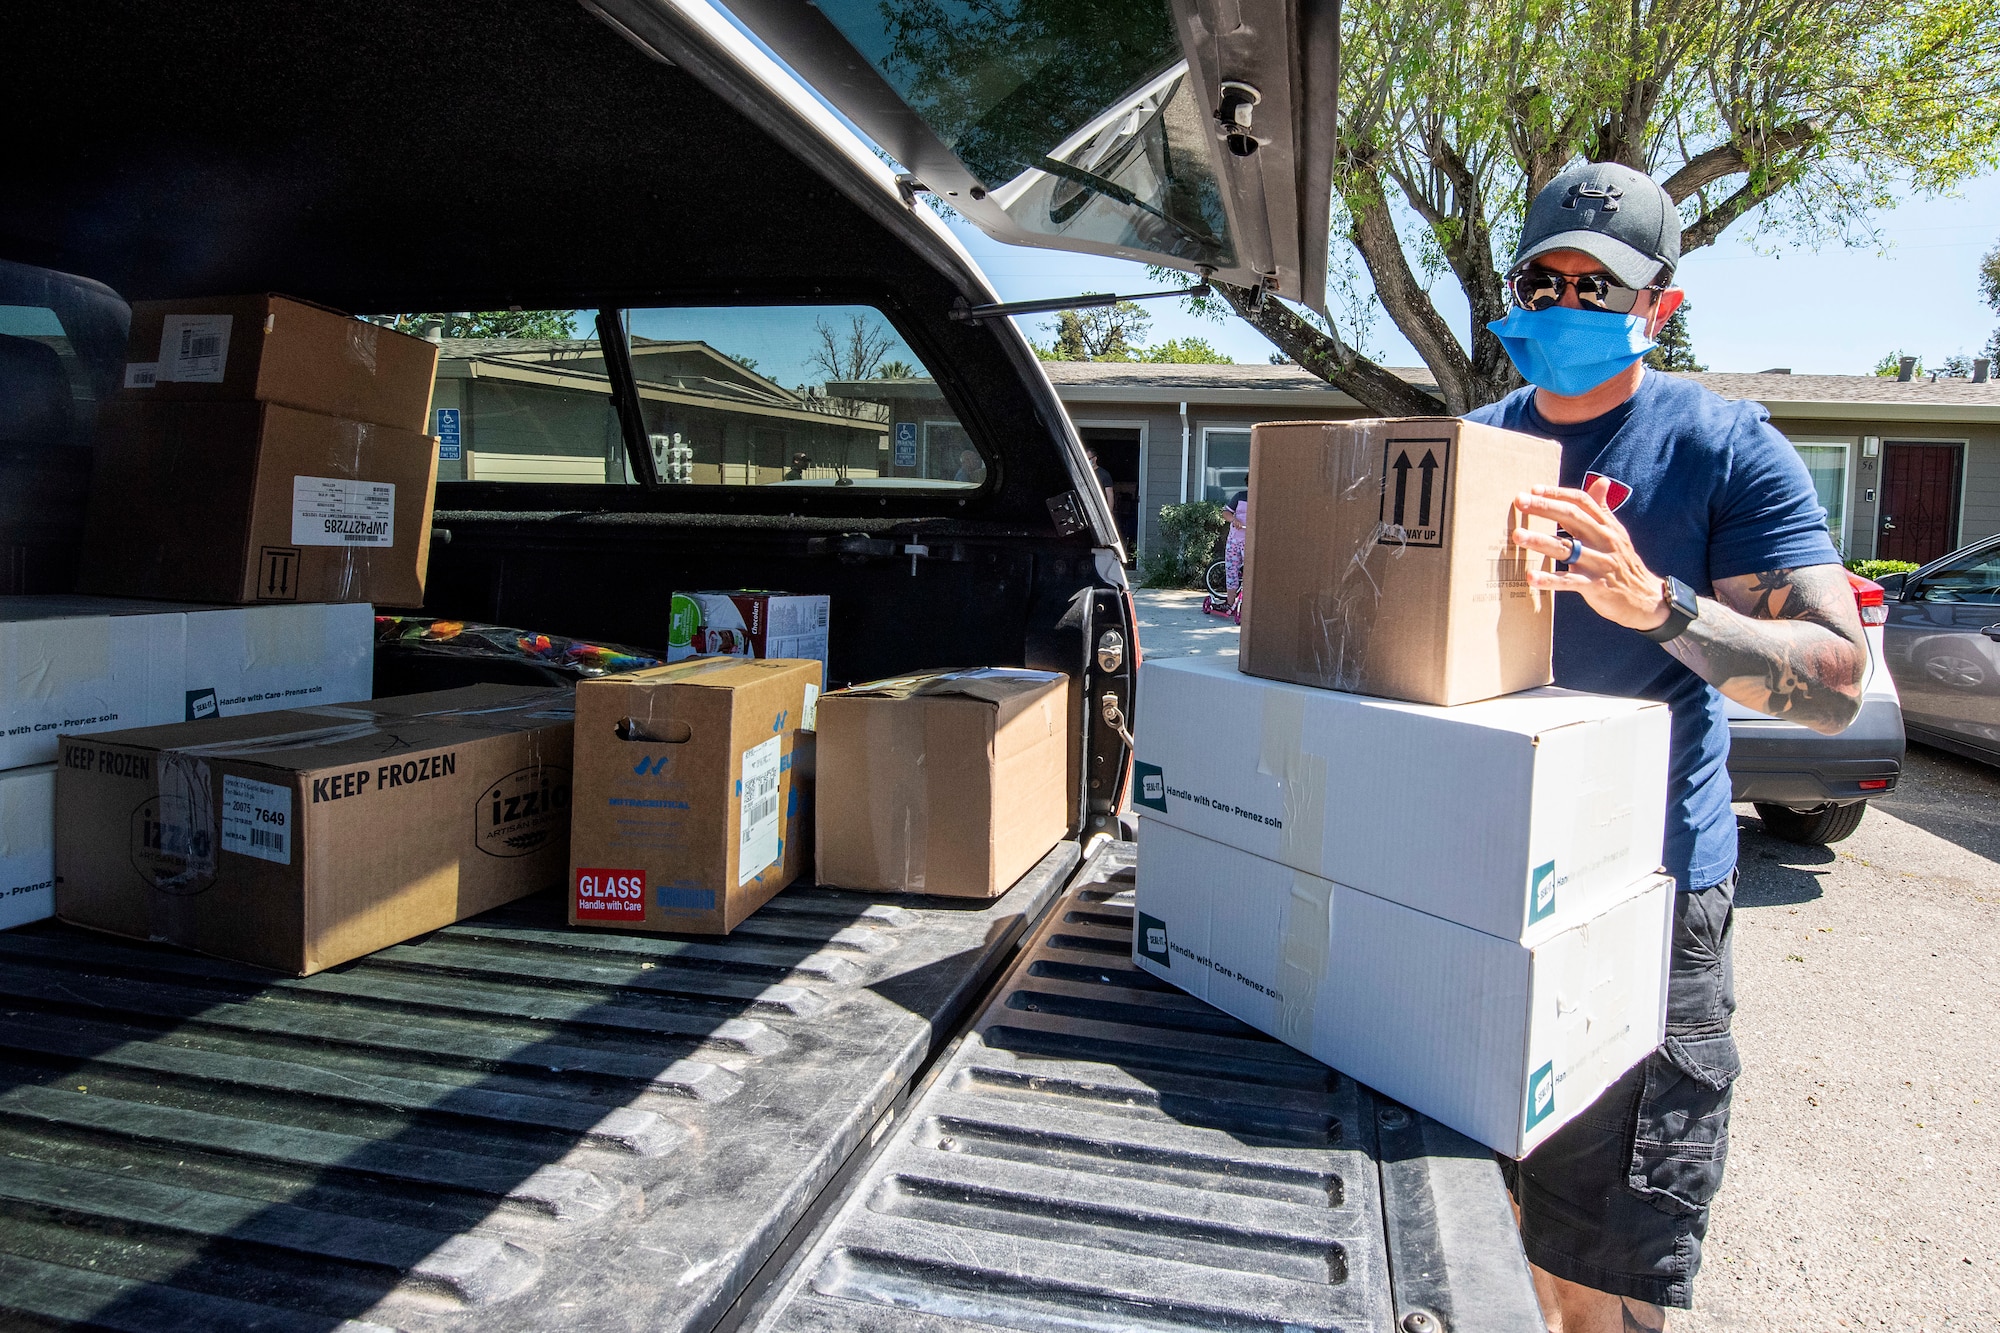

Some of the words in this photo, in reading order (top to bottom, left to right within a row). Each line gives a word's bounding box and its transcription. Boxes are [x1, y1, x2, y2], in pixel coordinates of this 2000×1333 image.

[1862, 460, 1873, 471] 56
[324, 519, 388, 535] JWP4277285
[1424, 530, 1436, 540] UP
[751, 601, 760, 635] Chocolate
[220, 697, 246, 706] Handle
[247, 694, 264, 702] with
[264, 692, 281, 700] Care
[285, 688, 308, 697] Prenez
[8, 726, 31, 736] with
[34, 722, 57, 732] Care
[64, 717, 97, 728] Prenez
[98, 712, 118, 722] soin
[65, 745, 95, 771] KEEP
[99, 750, 150, 780] FROZEN
[312, 770, 370, 803] KEEP
[378, 752, 456, 790] FROZEN
[232, 800, 251, 814] 20075
[493, 778, 569, 826] izzio
[1166, 786, 1192, 801] Handle
[1194, 795, 1210, 807] with
[1212, 800, 1230, 813] Care
[1235, 806, 1263, 823] Prenez
[1264, 818, 1282, 829] soin
[254, 808, 285, 826] 7649
[486, 822, 530, 839] ARTISAN
[12, 880, 52, 896] Prenez
[580, 876, 641, 898] GLASS
[579, 900, 605, 910] Handle
[606, 900, 622, 910] with
[624, 901, 641, 911] Care
[1170, 941, 1195, 960] Handle
[1196, 954, 1213, 969] with
[1214, 963, 1232, 977] Care
[1237, 972, 1264, 993] Prenez
[1266, 988, 1284, 1002] soin
